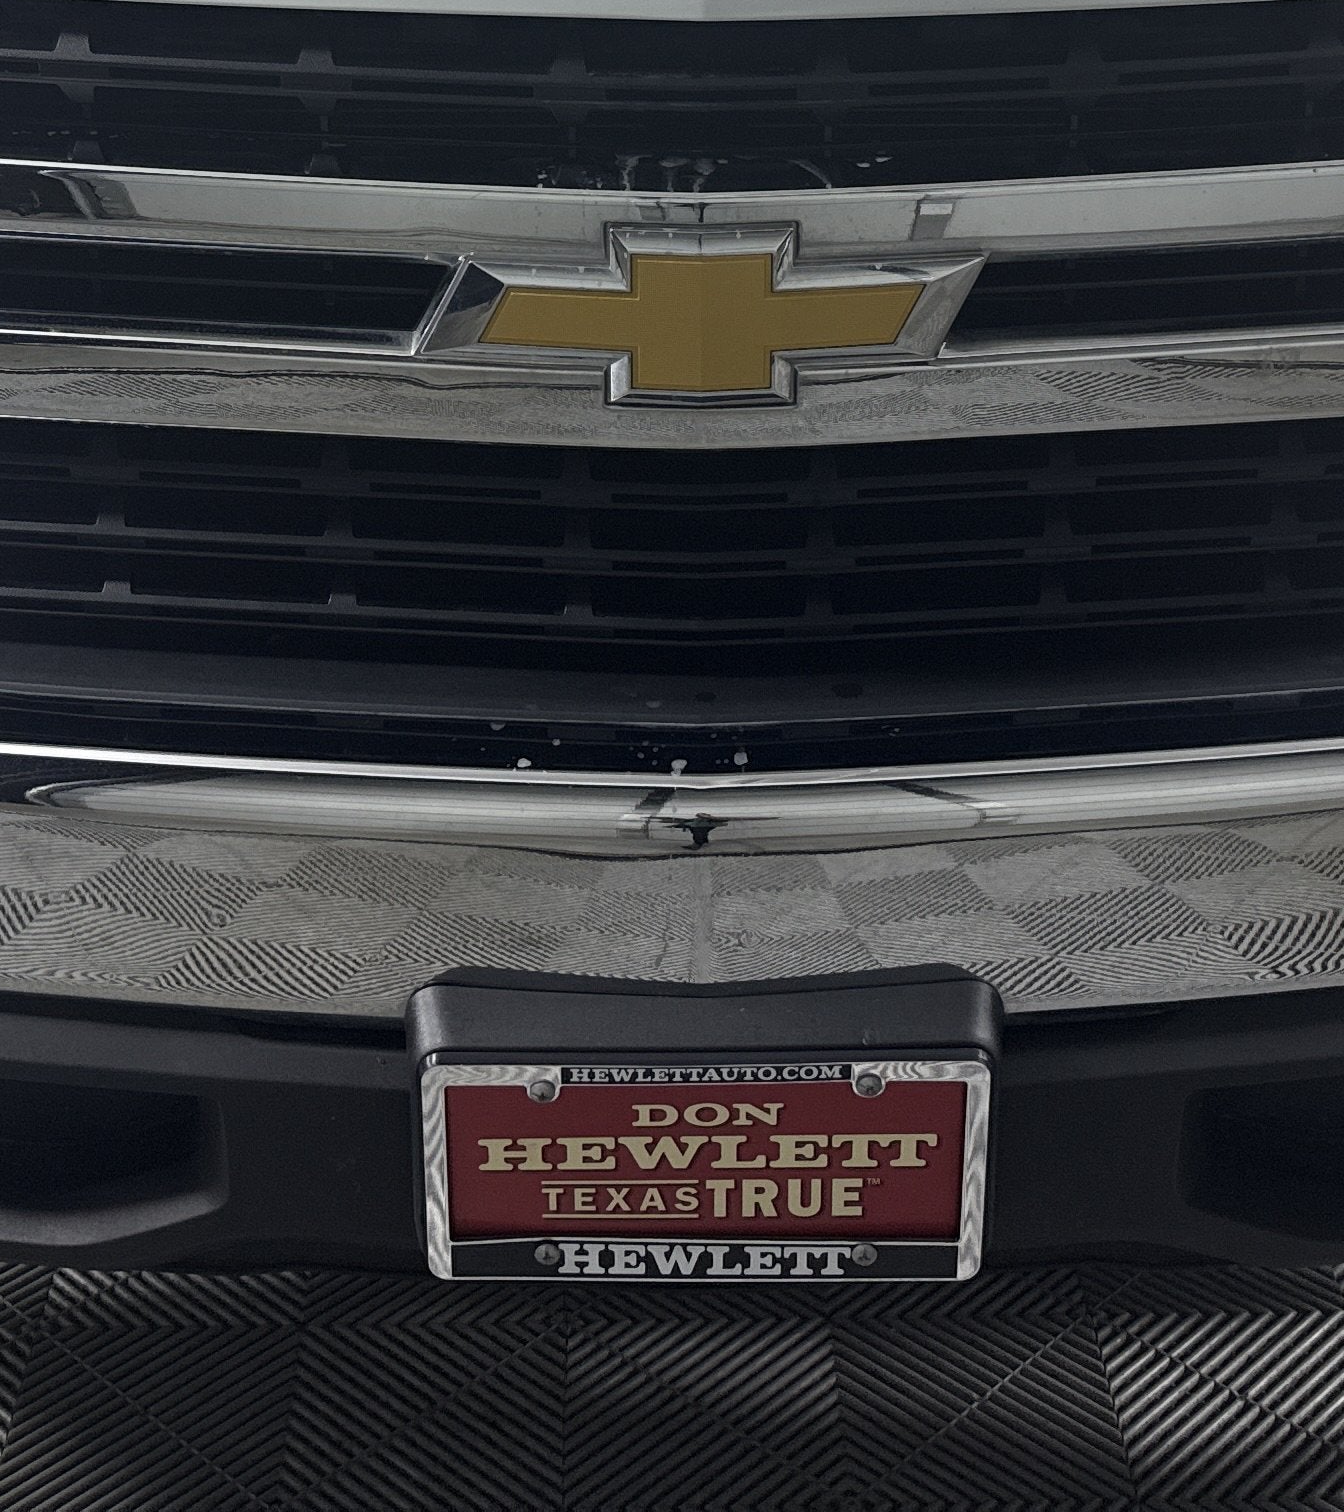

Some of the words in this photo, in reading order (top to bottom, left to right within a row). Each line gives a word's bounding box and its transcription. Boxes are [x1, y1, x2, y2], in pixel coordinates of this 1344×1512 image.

[568, 1064, 844, 1083] HEWLETTAUTO.COM
[630, 1102, 785, 1127] DON
[477, 1133, 938, 1171] HEWLETT
[557, 1242, 852, 1276] HEWLETT
